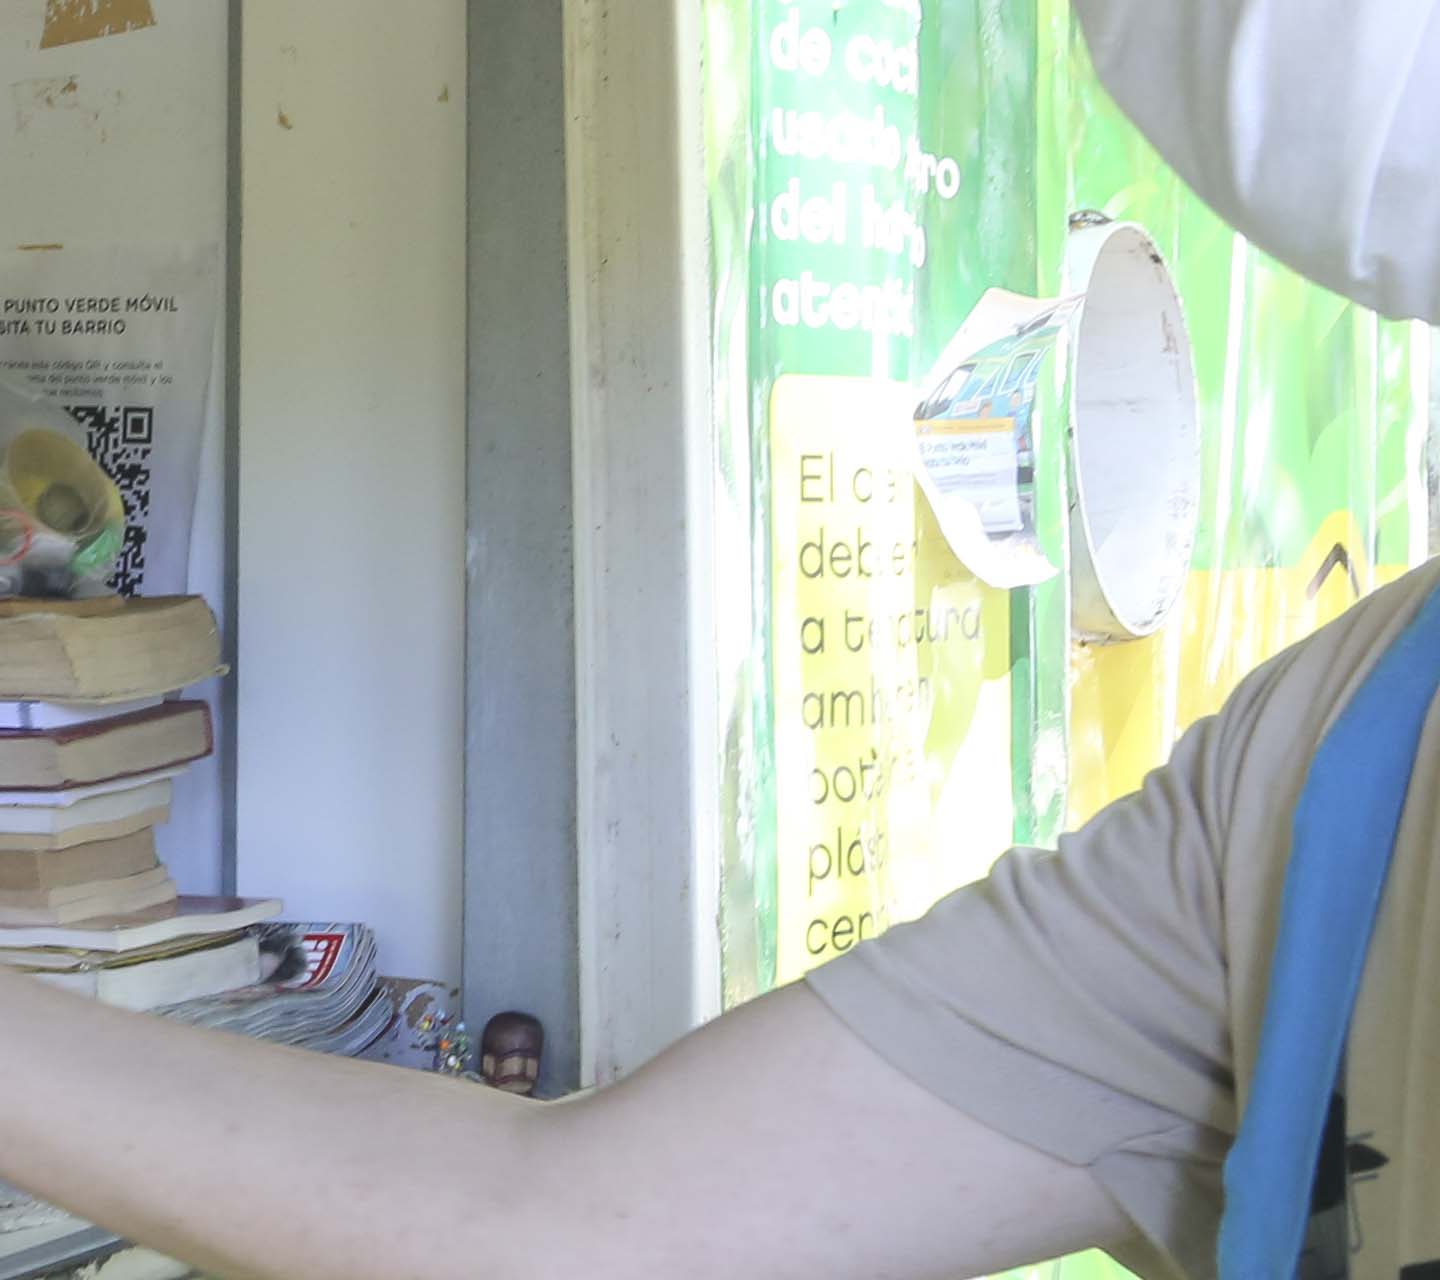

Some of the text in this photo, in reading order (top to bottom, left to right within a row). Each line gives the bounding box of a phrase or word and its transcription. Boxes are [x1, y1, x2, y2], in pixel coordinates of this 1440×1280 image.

[770, 7, 832, 76] de
[771, 177, 846, 245] del
[3, 297, 60, 315] PUNTO
[64, 296, 120, 314] VERDE
[125, 291, 179, 314] MÓVIL
[35, 320, 57, 335] TU
[62, 319, 126, 336] BARRIO
[799, 451, 834, 504] El
[801, 616, 825, 655] a
